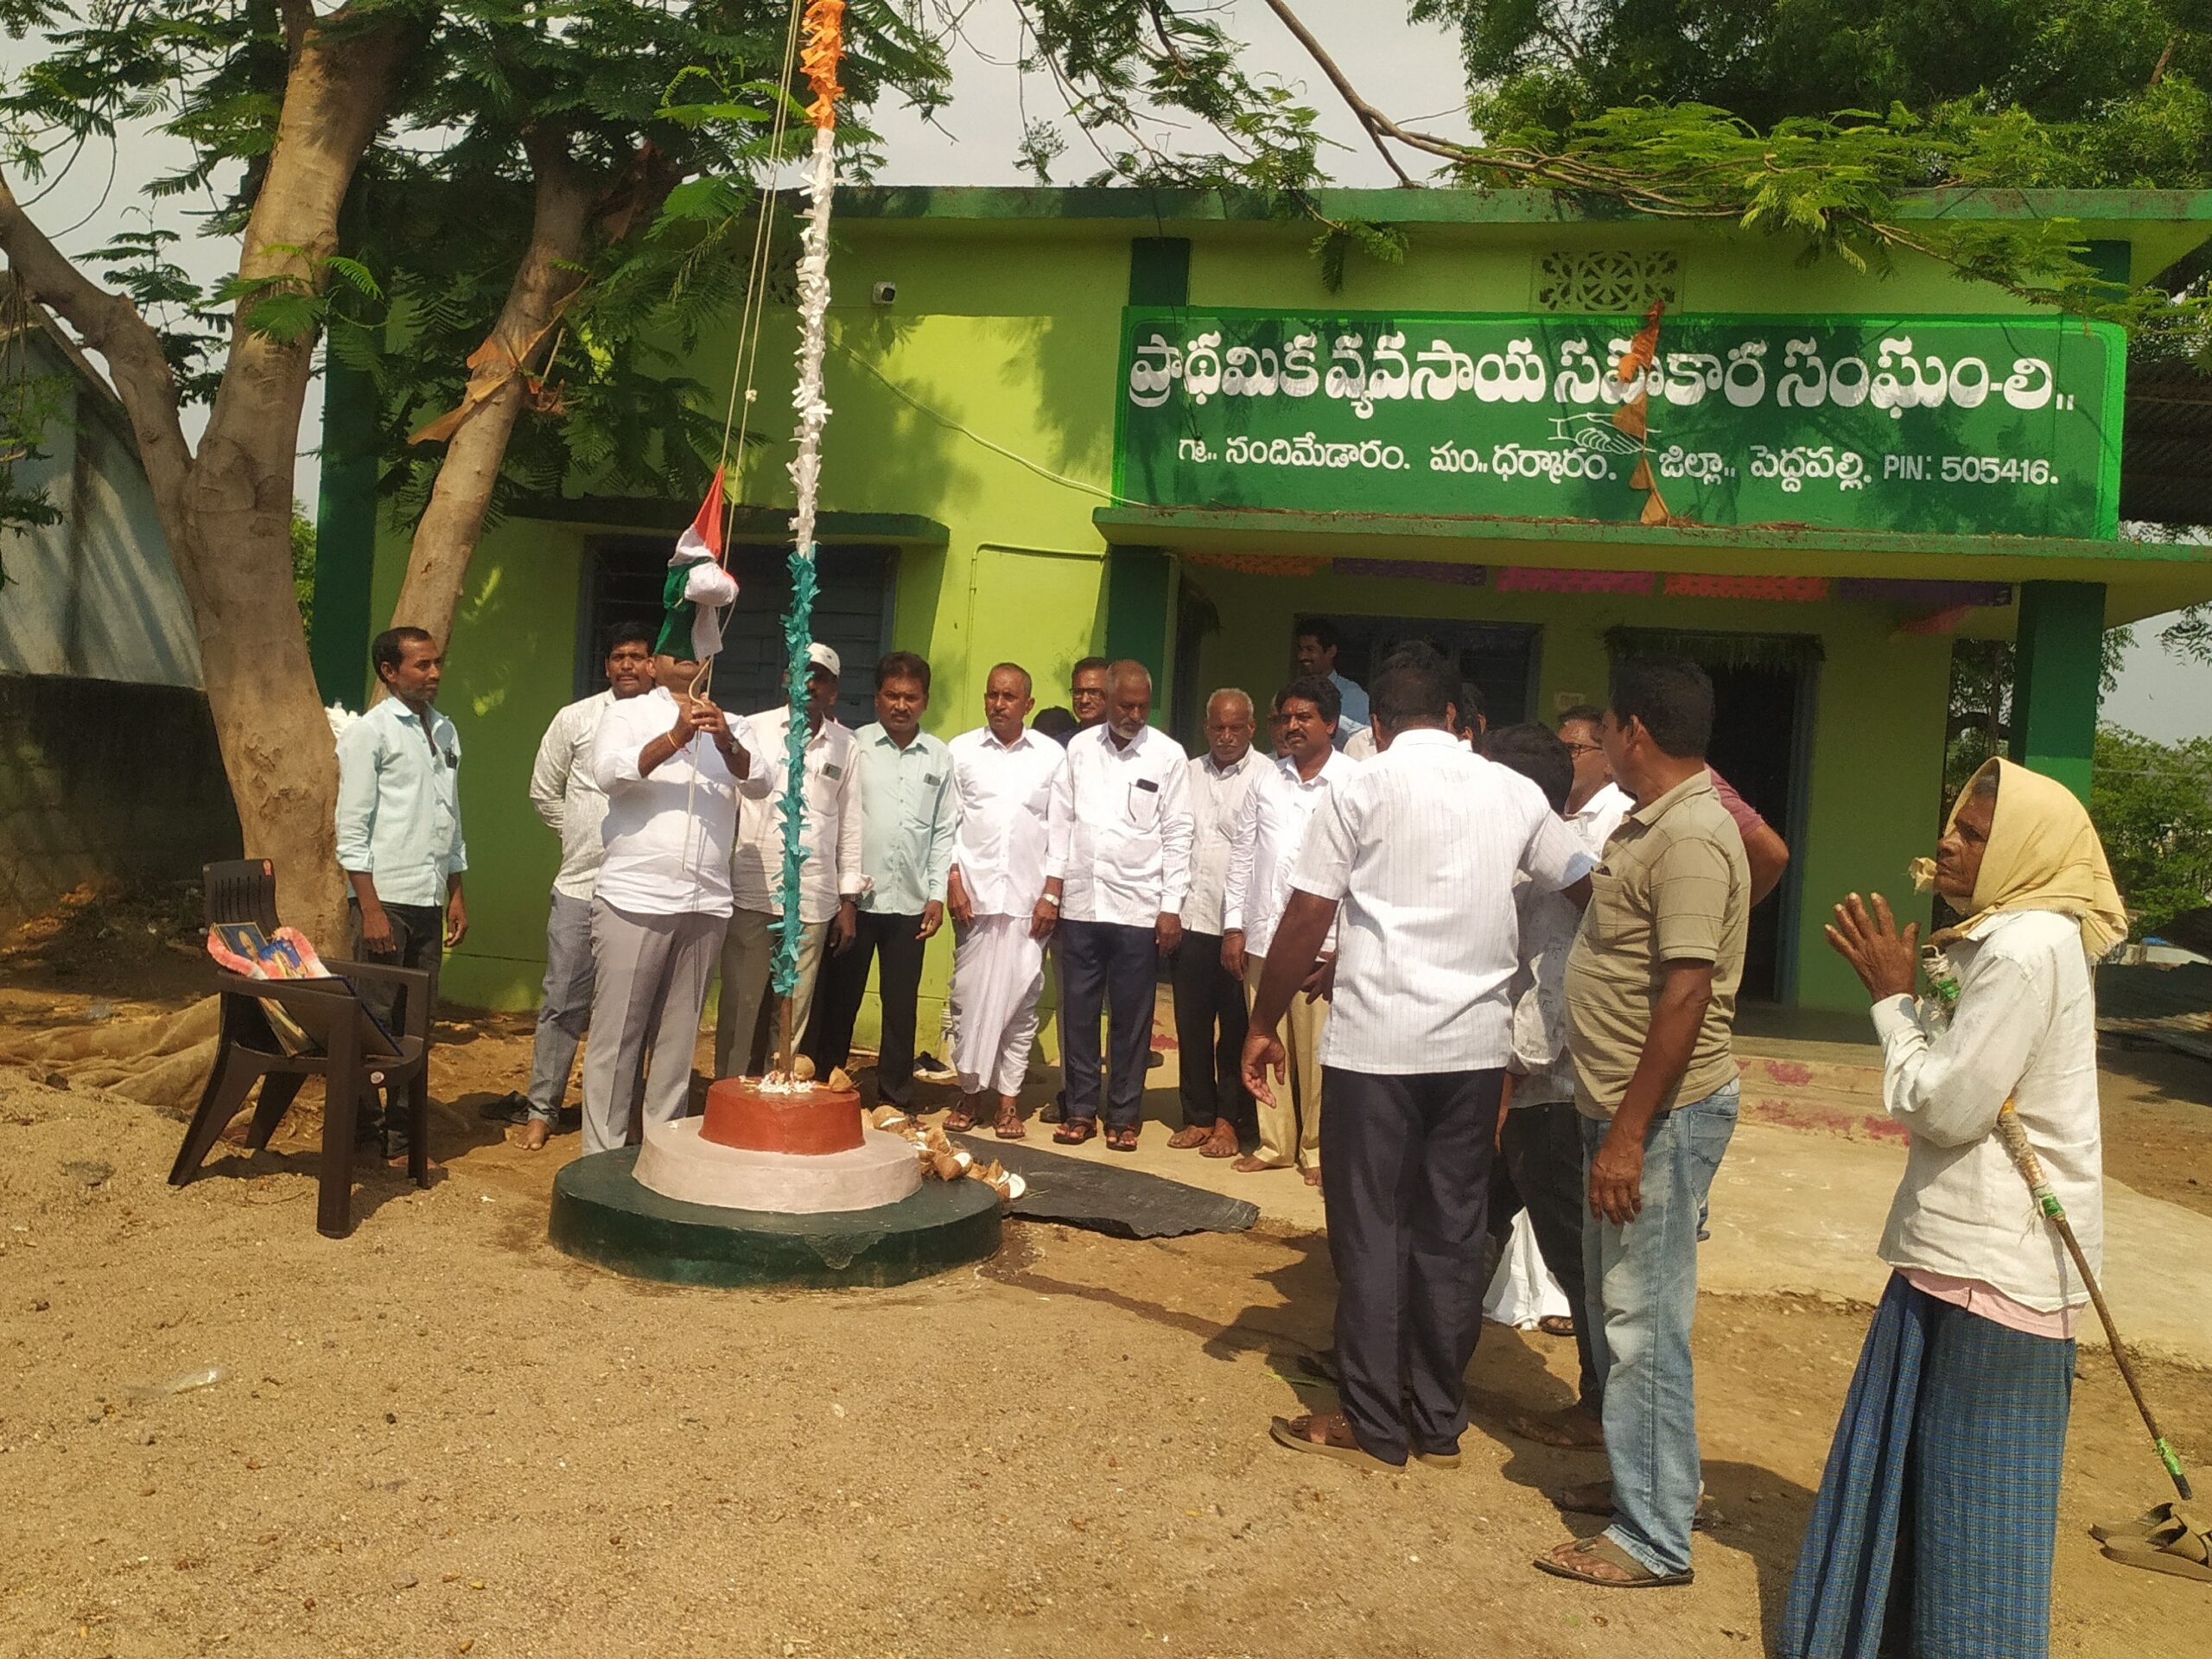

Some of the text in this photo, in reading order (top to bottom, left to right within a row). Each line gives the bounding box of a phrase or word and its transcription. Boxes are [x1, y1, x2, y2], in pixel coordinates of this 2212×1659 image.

[1325, 330, 1547, 419] వ్యవసాయ
[1884, 454, 1932, 480] PIN:
[1941, 456, 2059, 485] 505416.
